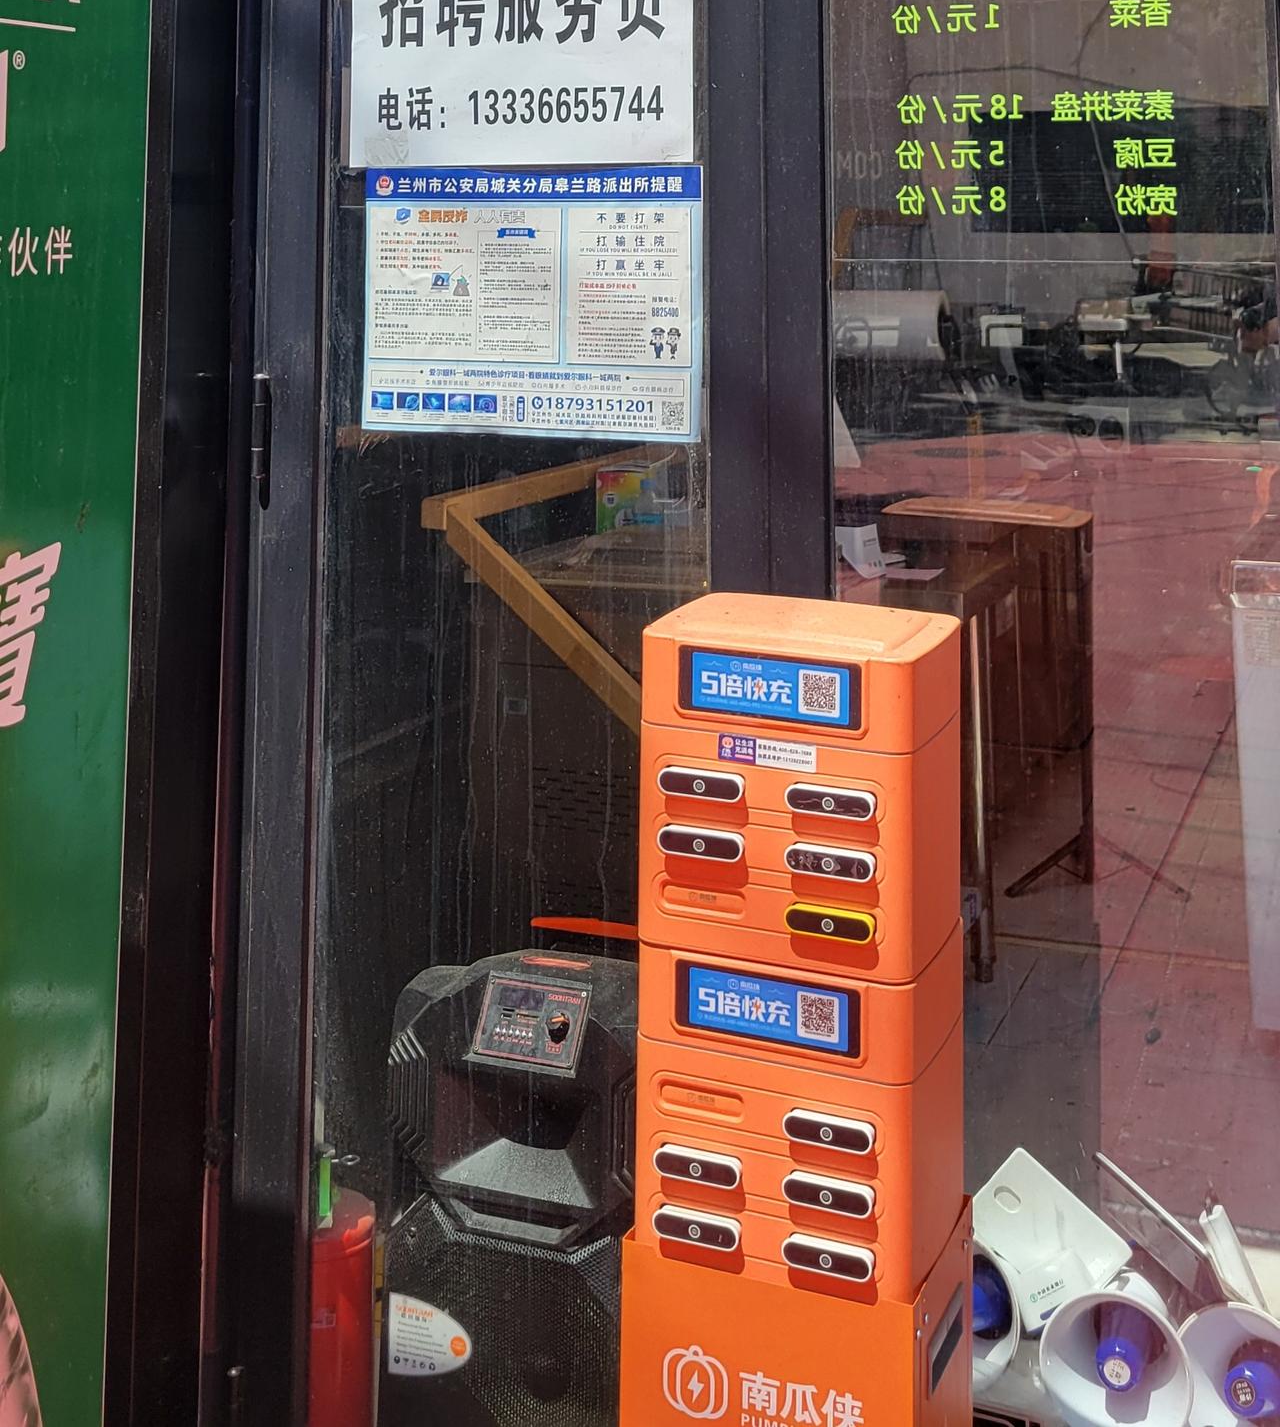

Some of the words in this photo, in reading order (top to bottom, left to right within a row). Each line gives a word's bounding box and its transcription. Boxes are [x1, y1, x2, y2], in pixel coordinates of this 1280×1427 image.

[397, 175, 684, 194] 兰州市公安局城关分局皋兰路派出所提醒
[596, 212, 665, 224] 不要打架
[596, 235, 665, 247] 打输住院
[0, 226, 73, 277] 伙伴
[596, 258, 665, 271] 打赢坐牢
[545, 396, 654, 413] 18793151201
[701, 670, 793, 705] 5倍快充
[698, 986, 791, 1027] 5倍快充
[739, 1371, 864, 1427] 南瓜侠
